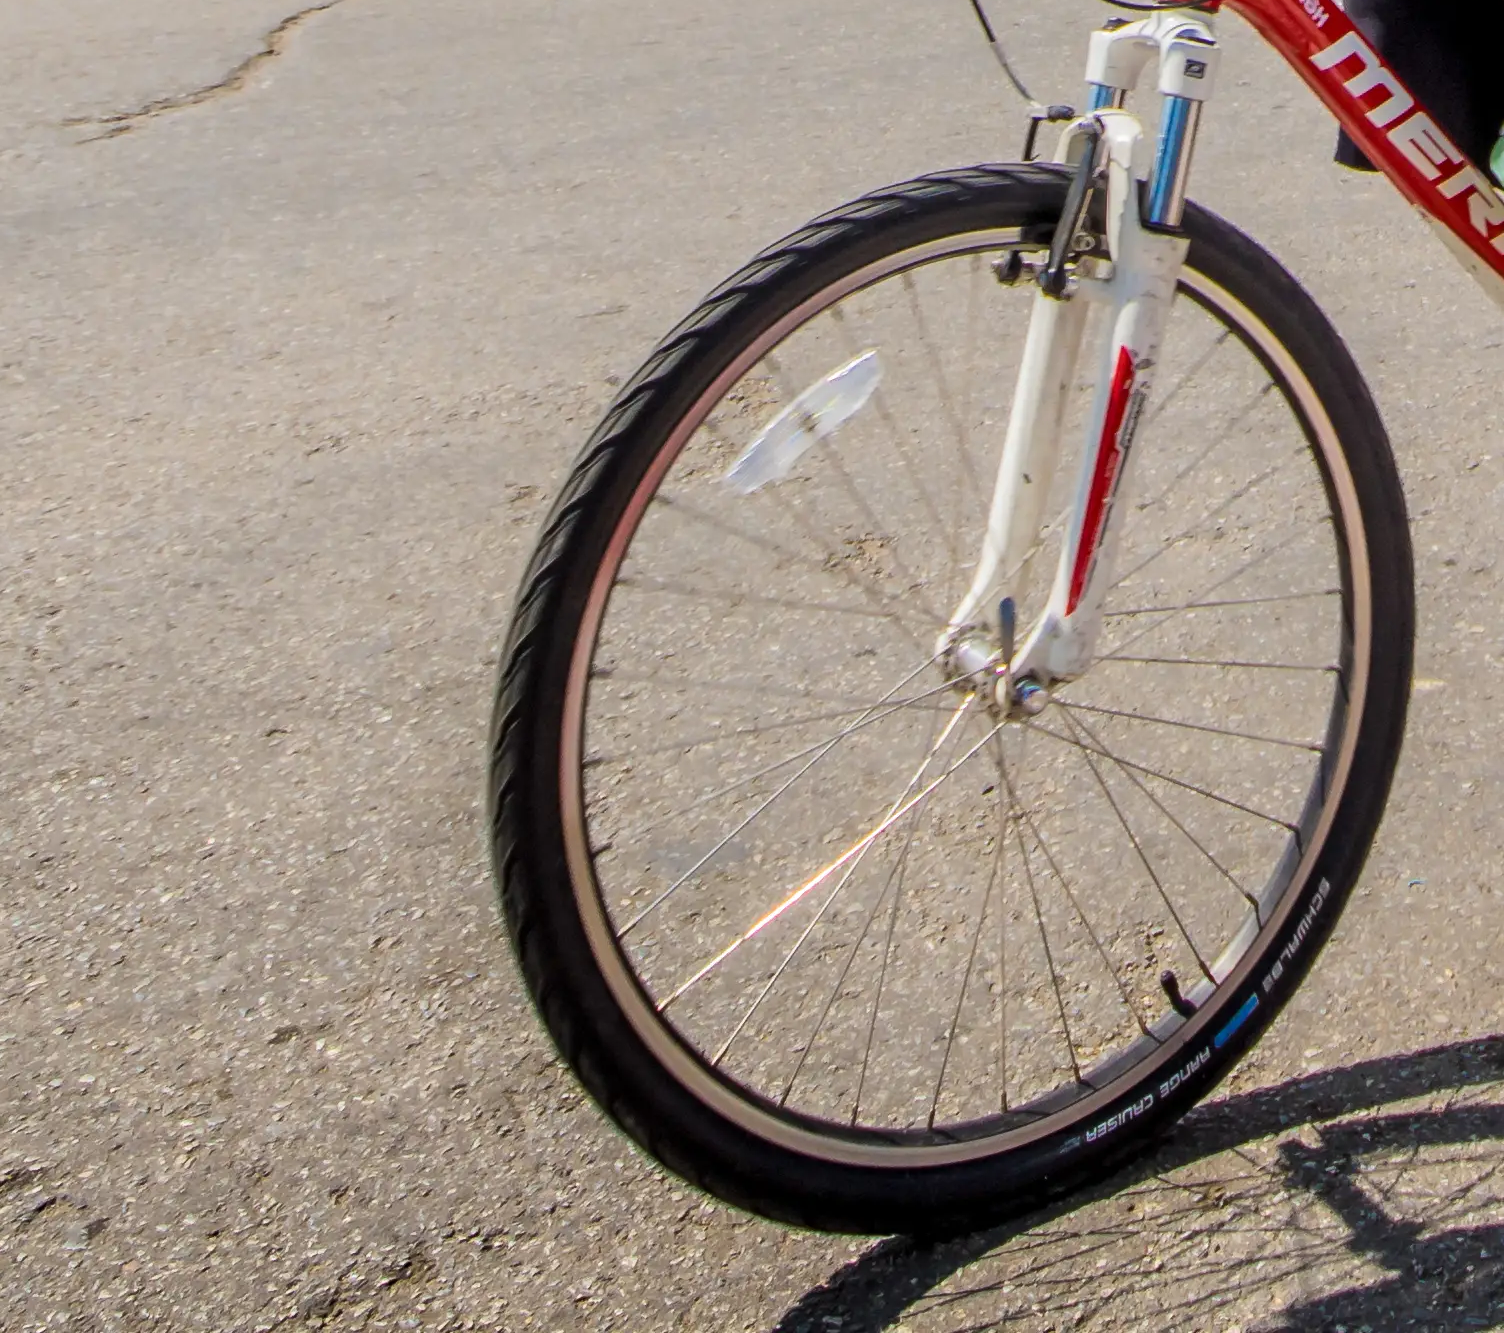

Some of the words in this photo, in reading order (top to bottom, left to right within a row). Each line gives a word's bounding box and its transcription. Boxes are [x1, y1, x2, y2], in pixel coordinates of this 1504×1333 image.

[1262, 876, 1330, 993] SCHWALBE
[1159, 1045, 1211, 1098] RANGE
[1086, 1093, 1154, 1141] CRUISER
